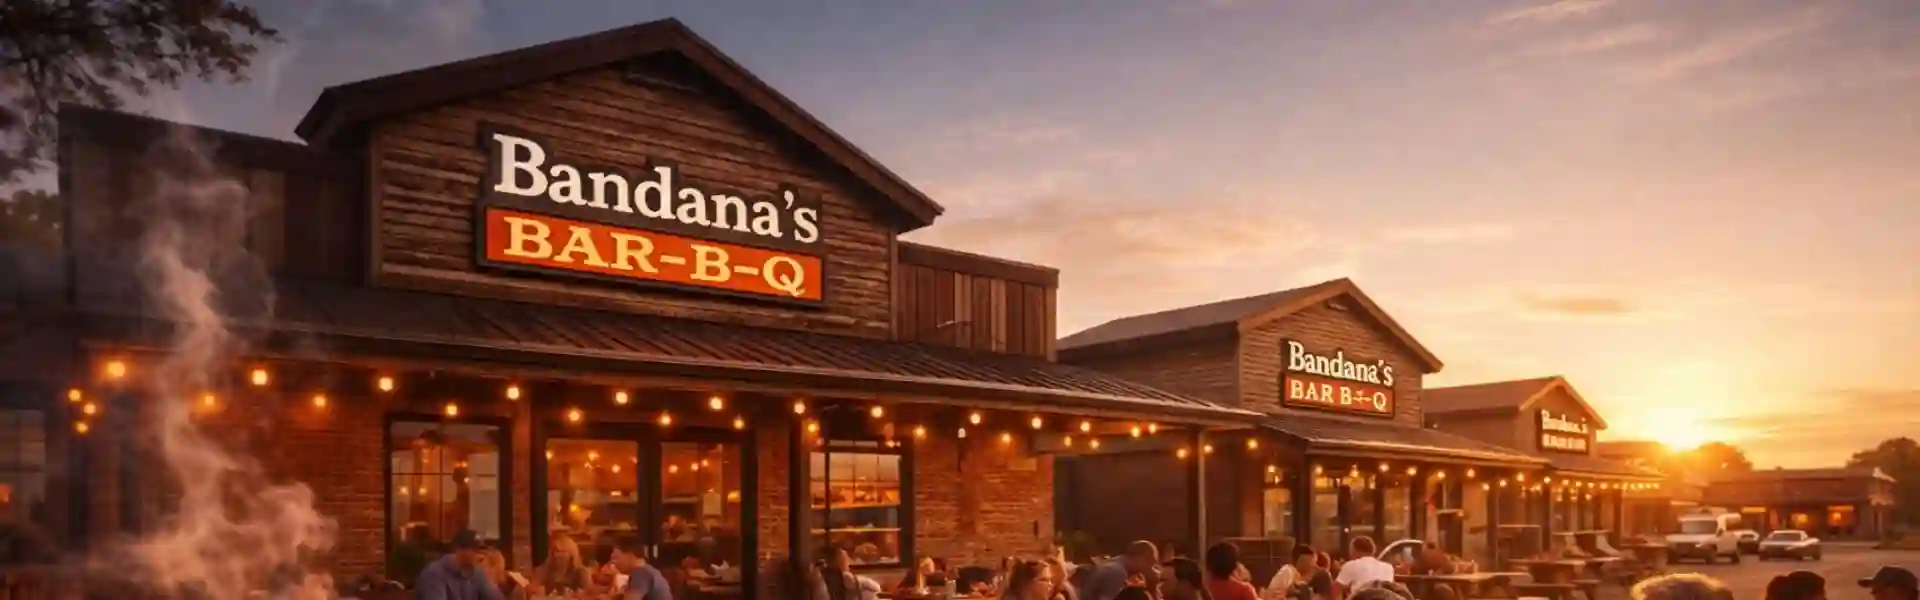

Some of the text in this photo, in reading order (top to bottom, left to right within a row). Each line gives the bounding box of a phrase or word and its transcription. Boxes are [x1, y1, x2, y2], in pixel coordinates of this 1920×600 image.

[493, 133, 819, 243] Bandana's
[503, 216, 805, 297] BAR-B-Q
[1288, 340, 1393, 386] Bandana's
[1290, 379, 1334, 403] BAR
